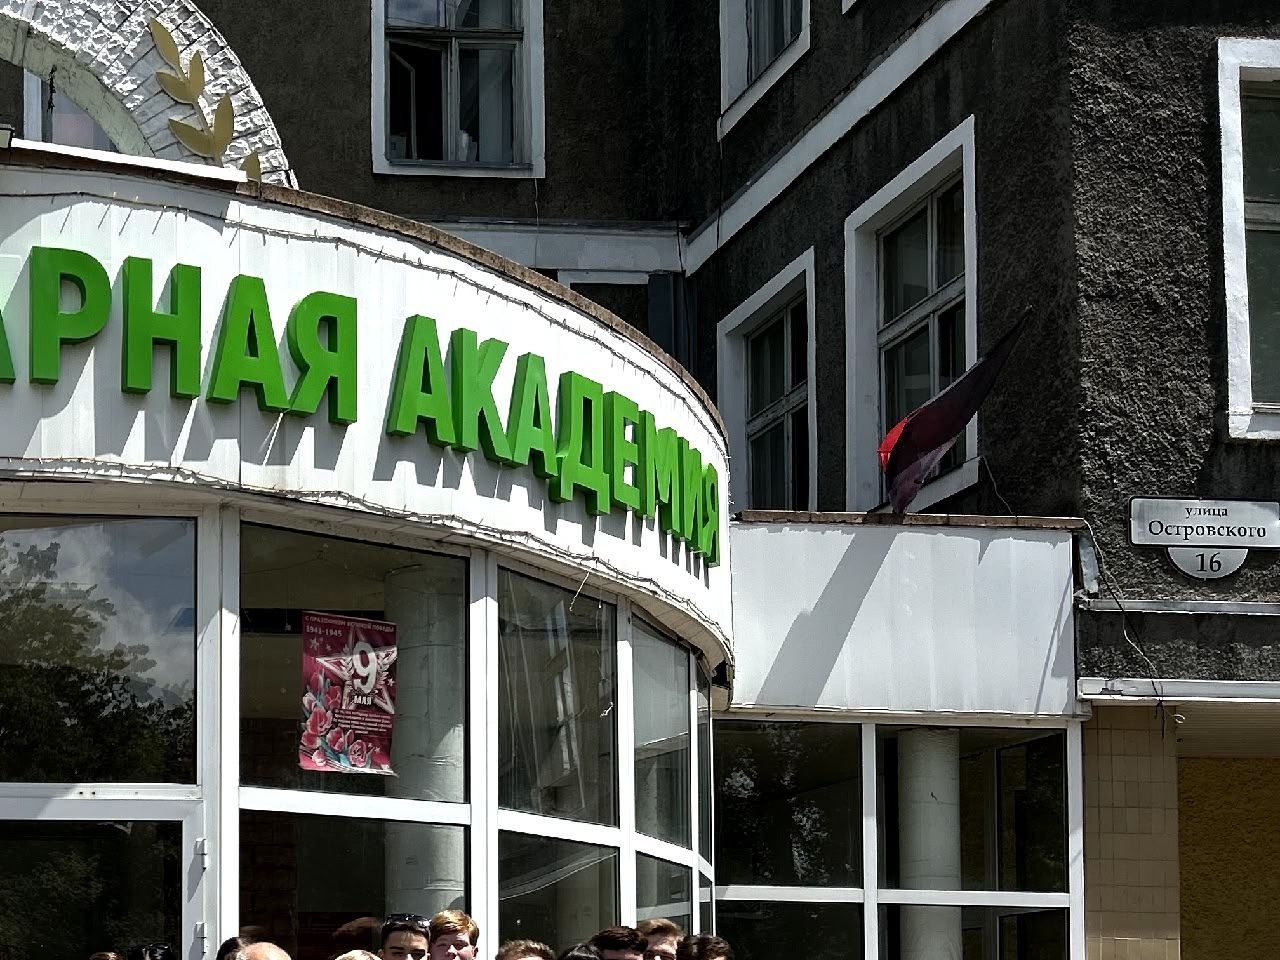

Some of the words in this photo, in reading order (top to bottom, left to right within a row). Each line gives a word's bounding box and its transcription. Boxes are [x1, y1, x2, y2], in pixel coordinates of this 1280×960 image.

[385, 314, 721, 568] АКАДЕМИЯ
[1185, 506, 1229, 519] улица
[1148, 520, 1266, 541] Островского
[1195, 552, 1222, 573] 16
[306, 625, 343, 637] 1941-1945
[352, 641, 378, 694] 9
[353, 695, 372, 706] МАЯ
